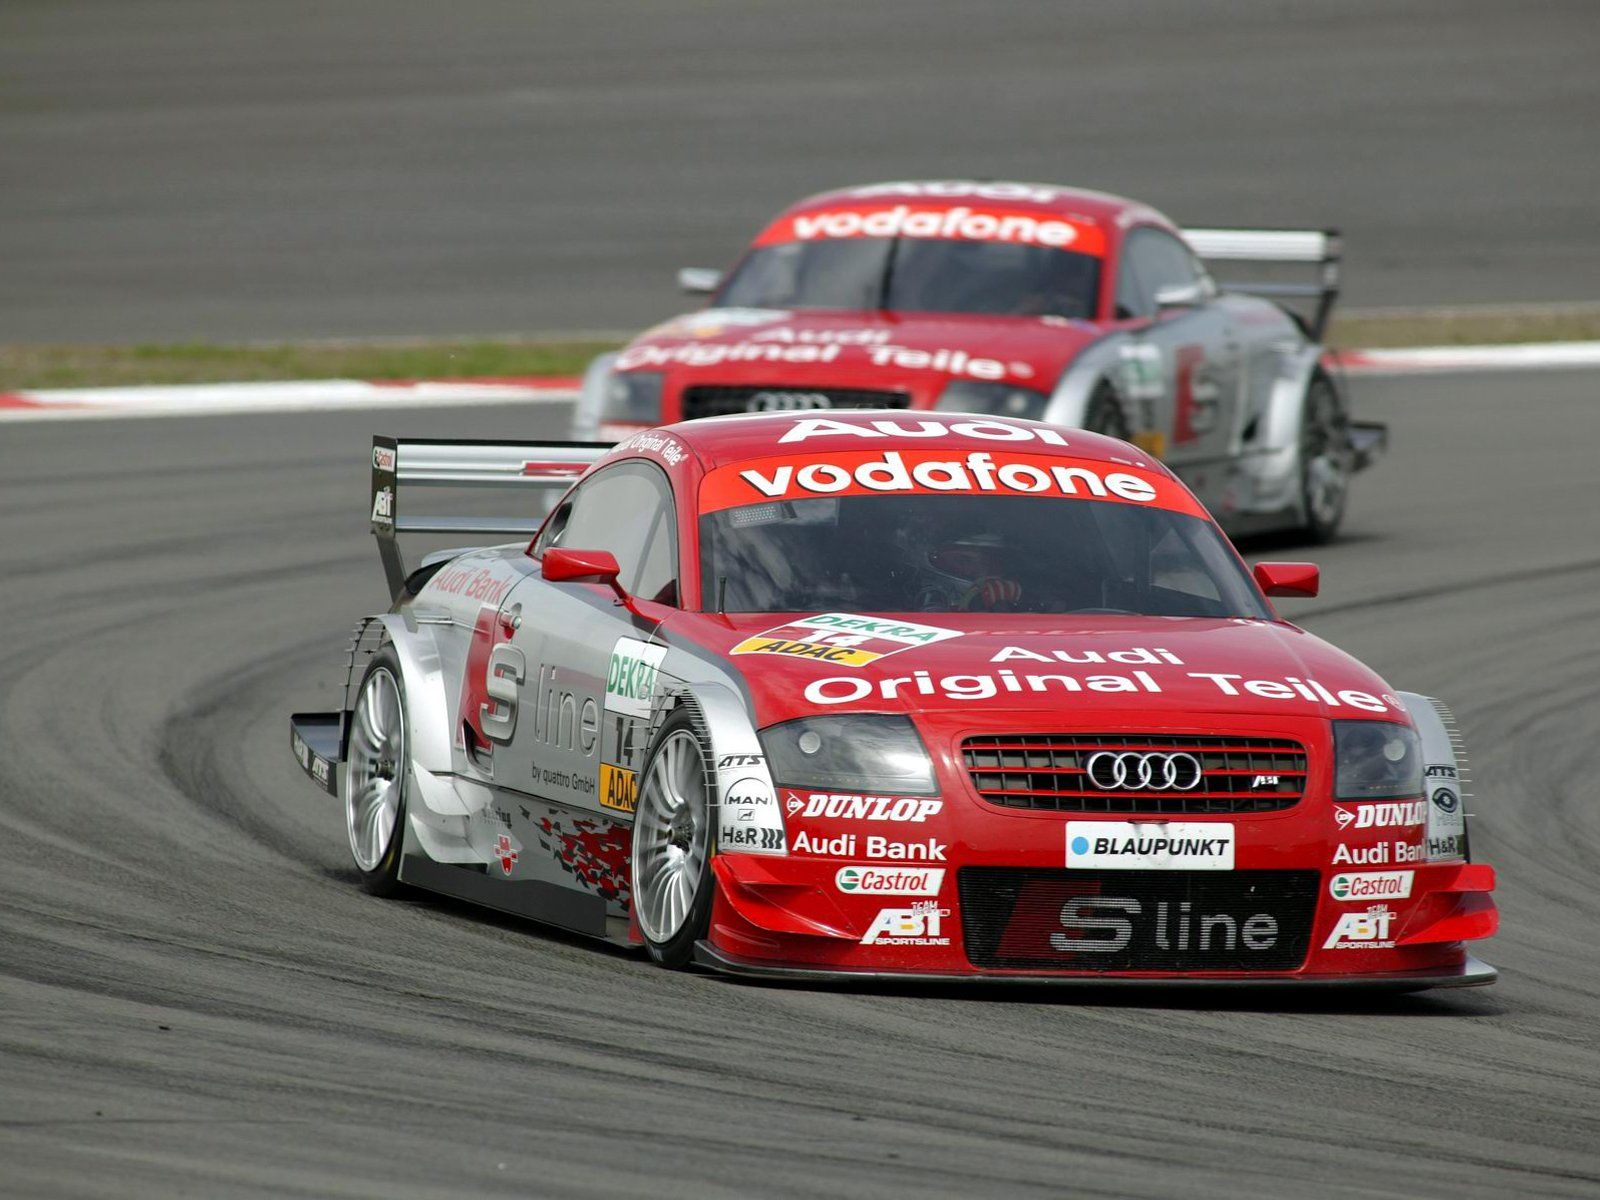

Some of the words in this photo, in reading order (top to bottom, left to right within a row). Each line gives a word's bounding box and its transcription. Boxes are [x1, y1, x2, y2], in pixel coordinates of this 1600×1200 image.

[793, 204, 1077, 246] vodafone
[752, 327, 890, 345] Audi
[615, 345, 841, 370] Original
[777, 419, 1069, 447] Audi
[739, 451, 1157, 502] vodafone
[428, 567, 478, 595] Audi
[464, 568, 514, 606] Bank
[797, 629, 874, 647] 14
[803, 616, 939, 641] DEKRA
[755, 641, 855, 661] ADAC
[990, 646, 1185, 665] Audi
[607, 653, 655, 701] DEKRA
[804, 670, 1162, 705] Original
[479, 643, 526, 747] S
[534, 664, 599, 757] line
[616, 716, 635, 766] 14
[718, 755, 766, 767] ATS
[1425, 765, 1457, 777] ATS
[532, 760, 541, 783] by
[543, 769, 570, 788] quattro
[572, 773, 595, 796] GmbH
[607, 768, 640, 810] ADAC
[728, 796, 768, 805] MAN
[802, 794, 944, 822] DUNLOP
[722, 826, 757, 844] H&R
[792, 831, 857, 856] Audi
[866, 836, 948, 861] Bank
[1094, 837, 1229, 856] BLAUPUNKT
[1331, 841, 1388, 864] Audi
[1395, 838, 1425, 862] Ban
[861, 871, 928, 891] Castrol
[1351, 876, 1402, 896] Castrol
[859, 908, 950, 944] ABT
[1050, 897, 1142, 952] S
[1156, 902, 1279, 950] line
[1322, 913, 1397, 949] ABT
